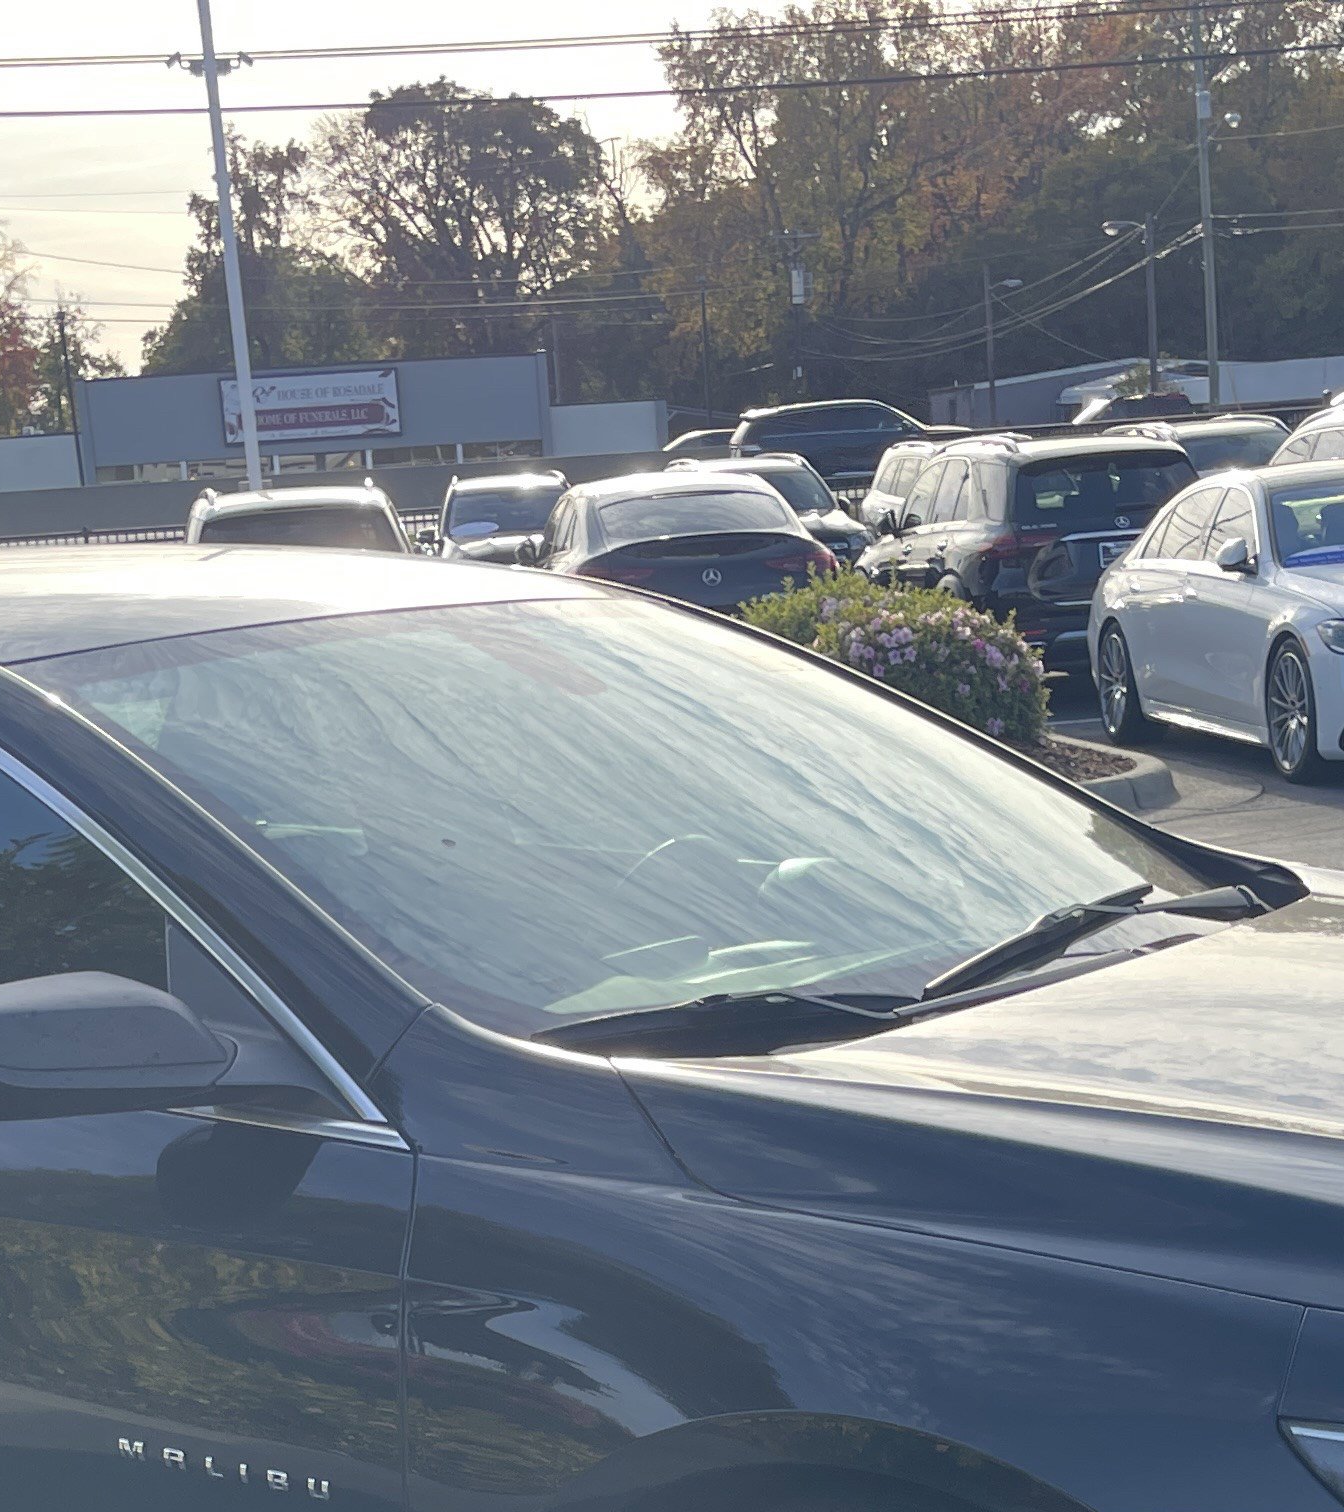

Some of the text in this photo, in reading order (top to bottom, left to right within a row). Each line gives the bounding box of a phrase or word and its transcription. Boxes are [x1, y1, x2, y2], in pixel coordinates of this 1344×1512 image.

[277, 388, 312, 401] HOUSE
[315, 386, 329, 398] OF
[284, 412, 297, 424] OF
[351, 408, 368, 420] LLC
[118, 1438, 330, 1500] MALIBU
